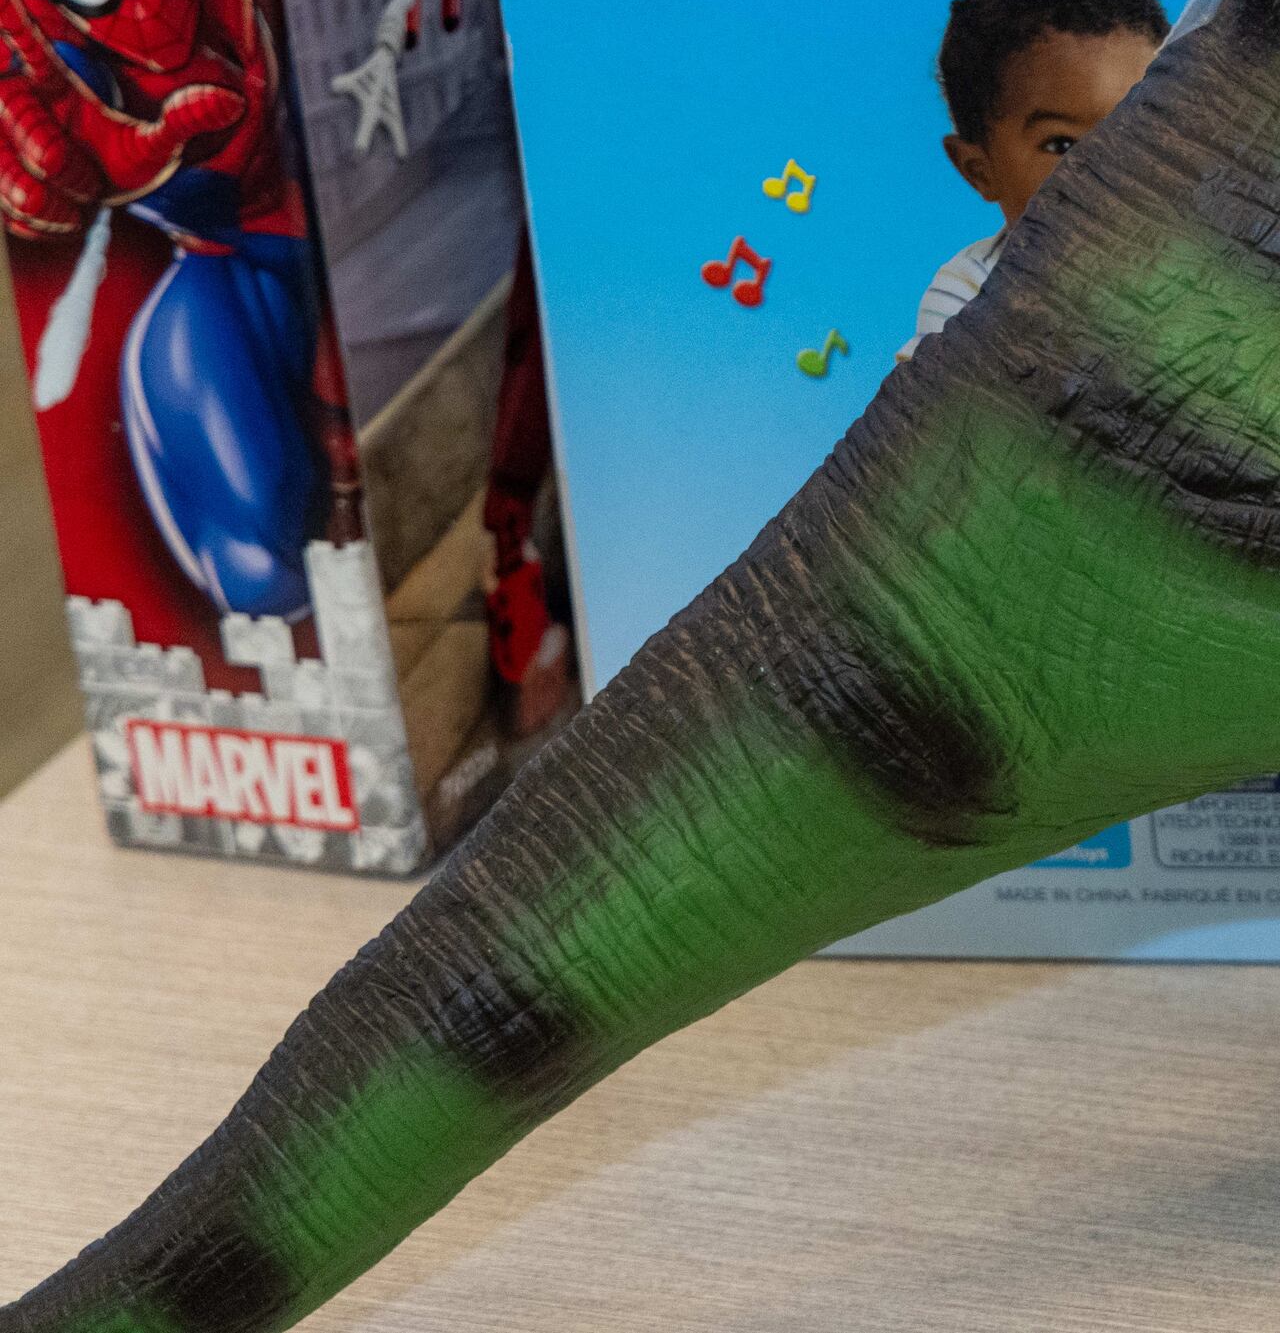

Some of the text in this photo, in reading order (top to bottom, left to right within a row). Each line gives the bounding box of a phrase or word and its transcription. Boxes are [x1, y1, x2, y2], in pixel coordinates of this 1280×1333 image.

[133, 724, 355, 825] MARVEL
[996, 886, 1048, 903] MADE
[1235, 888, 1263, 905] EN
